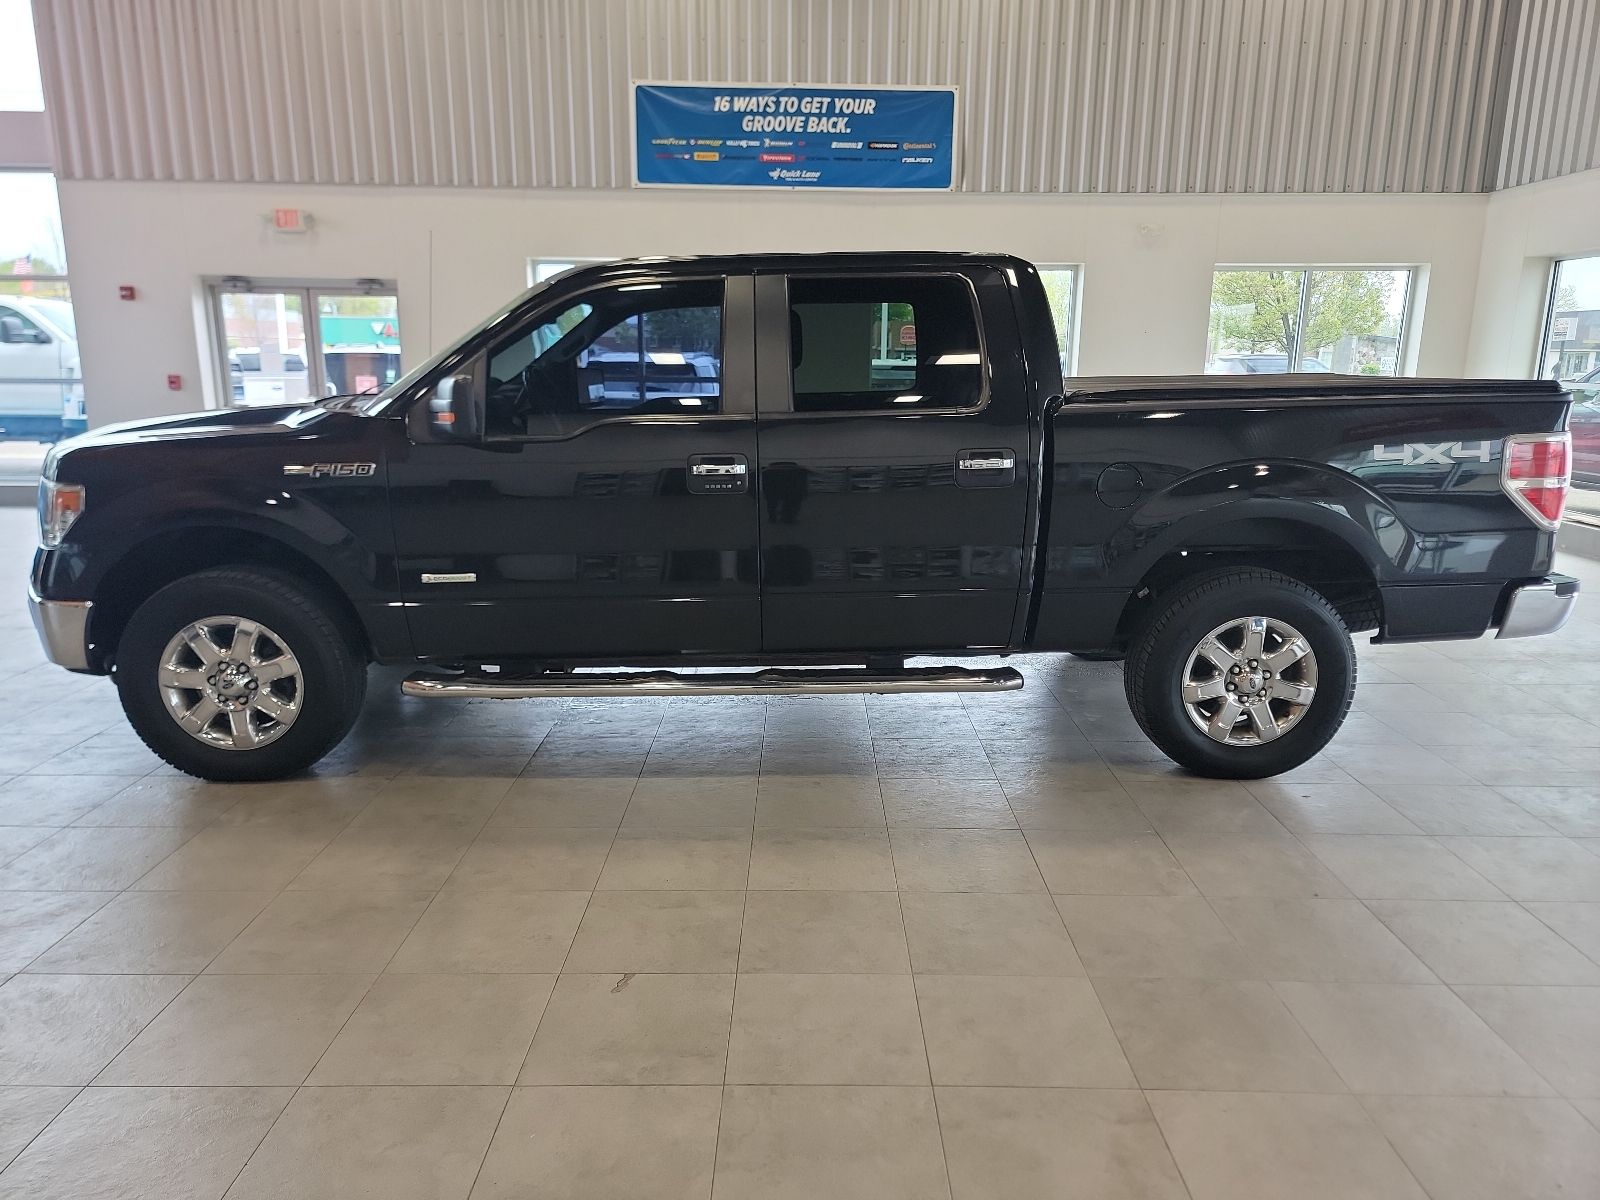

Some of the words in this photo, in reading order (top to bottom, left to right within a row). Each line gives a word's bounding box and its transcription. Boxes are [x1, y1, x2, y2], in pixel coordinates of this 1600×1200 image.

[713, 96, 731, 112] 16
[733, 96, 777, 113] WAYS
[779, 97, 799, 114] TO
[801, 97, 831, 114] GET
[834, 98, 877, 115] YOUR
[742, 115, 804, 133] GROOVE
[806, 117, 852, 134] BACK.
[780, 169, 801, 178] Quick
[801, 170, 821, 178] Lane
